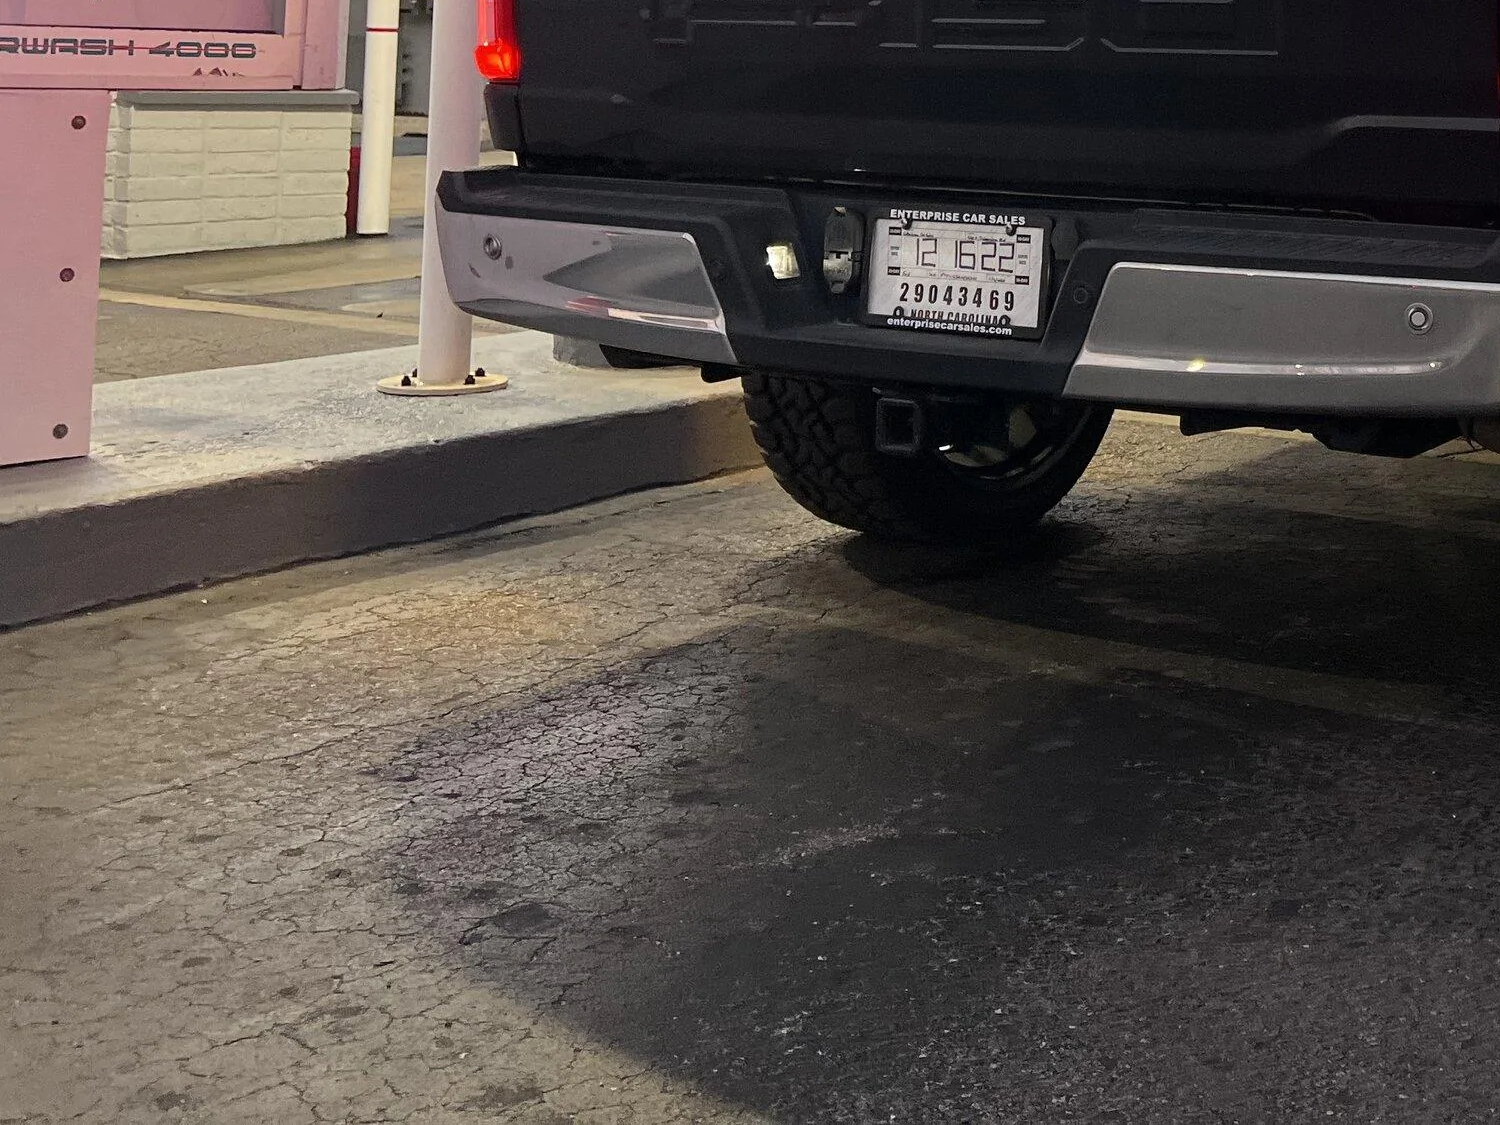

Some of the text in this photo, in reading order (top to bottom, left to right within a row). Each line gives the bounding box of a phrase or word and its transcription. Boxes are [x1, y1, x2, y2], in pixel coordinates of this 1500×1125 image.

[149, 41, 257, 59] 4000
[890, 208, 1026, 226] ENTERPRISE CAR SALES
[916, 238, 1015, 273] 12 16 22
[899, 282, 1015, 312] 29043469
[910, 308, 999, 324] NORTH CAROLINA
[886, 317, 1013, 336] enterprisecarsales.com
